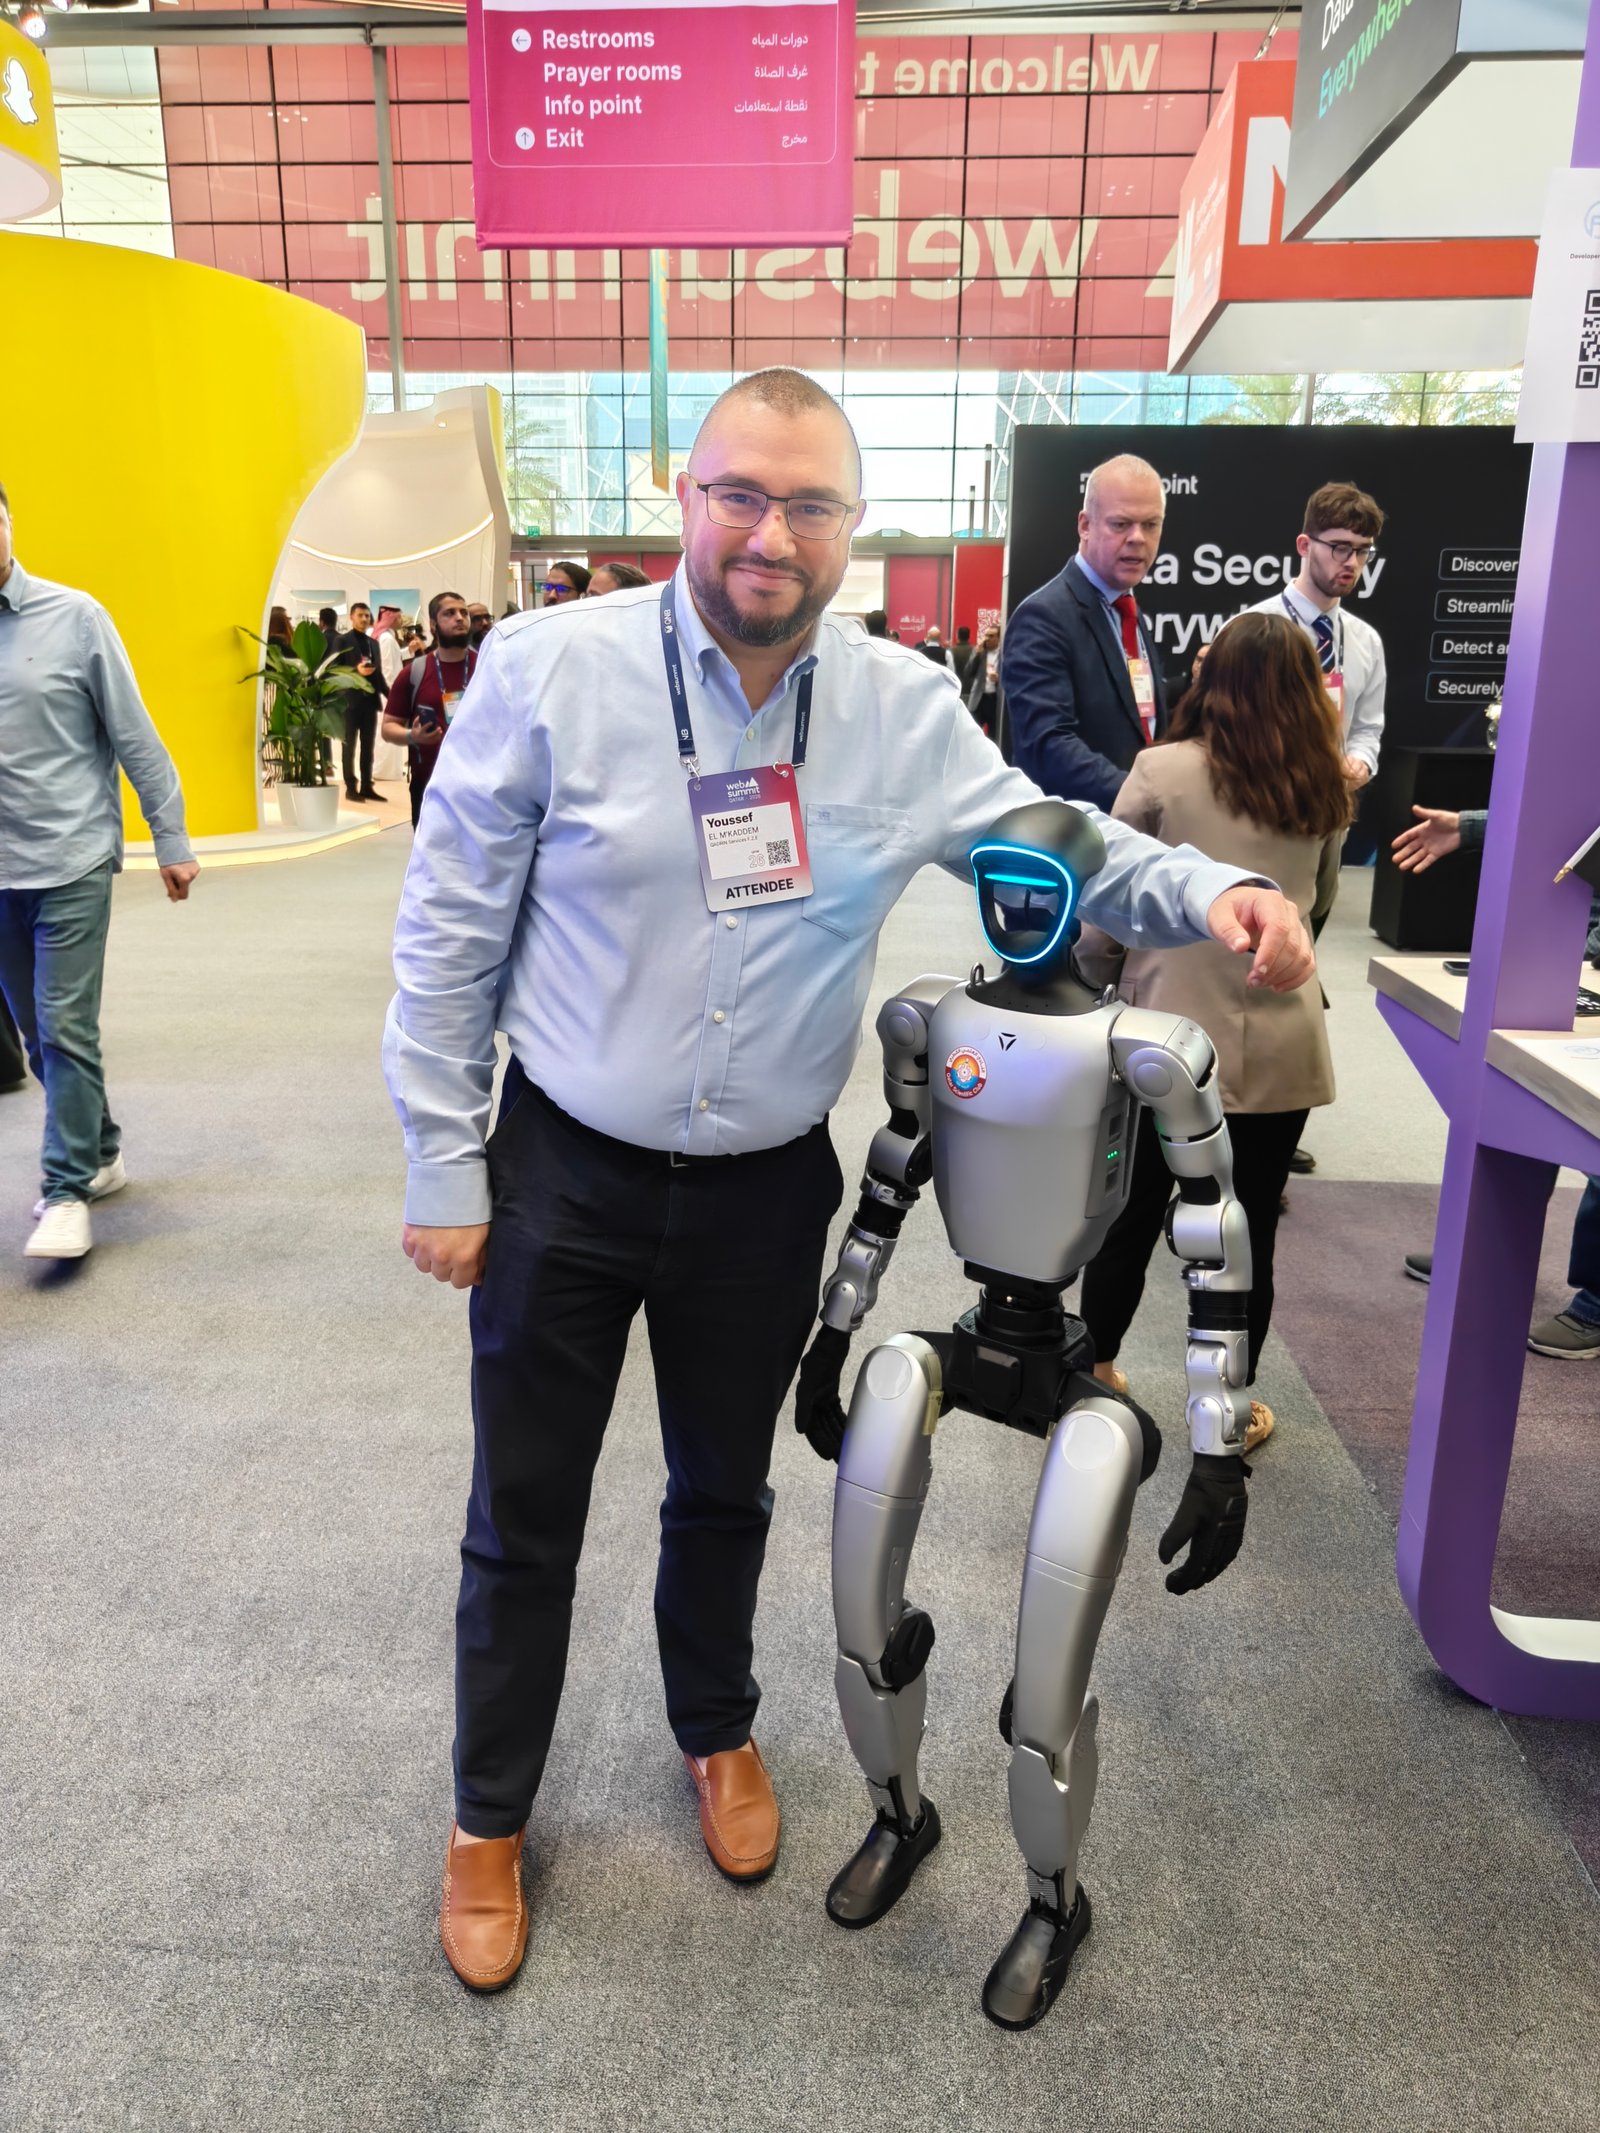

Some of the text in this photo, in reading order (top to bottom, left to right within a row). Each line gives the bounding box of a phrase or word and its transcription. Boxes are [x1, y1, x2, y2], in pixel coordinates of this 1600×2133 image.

[543, 29, 655, 50] Restrooms
[752, 32, 808, 48] دورات المياه
[1319, 0, 1412, 119] Everywhe
[544, 63, 682, 87] Prayer rooms
[754, 63, 808, 80] غرف الصلاة
[545, 94, 642, 120] Info point
[734, 99, 808, 113] نقطة استعلامات
[546, 127, 584, 148] Exit
[781, 133, 807, 148] مخرج
[1192, 543, 1386, 599] Secuy
[1451, 556, 1519, 572] Discover
[663, 608, 673, 625] QNB
[1442, 639, 1494, 655] Detect
[1438, 680, 1504, 698] Securely
[681, 728, 689, 741] NB
[726, 779, 746, 791] web
[727, 786, 760, 798] summit
[707, 812, 753, 828] Youssef
[708, 833, 718, 841] EL
[748, 853, 765, 869] 26
[725, 878, 795, 900] ATTENDEE
